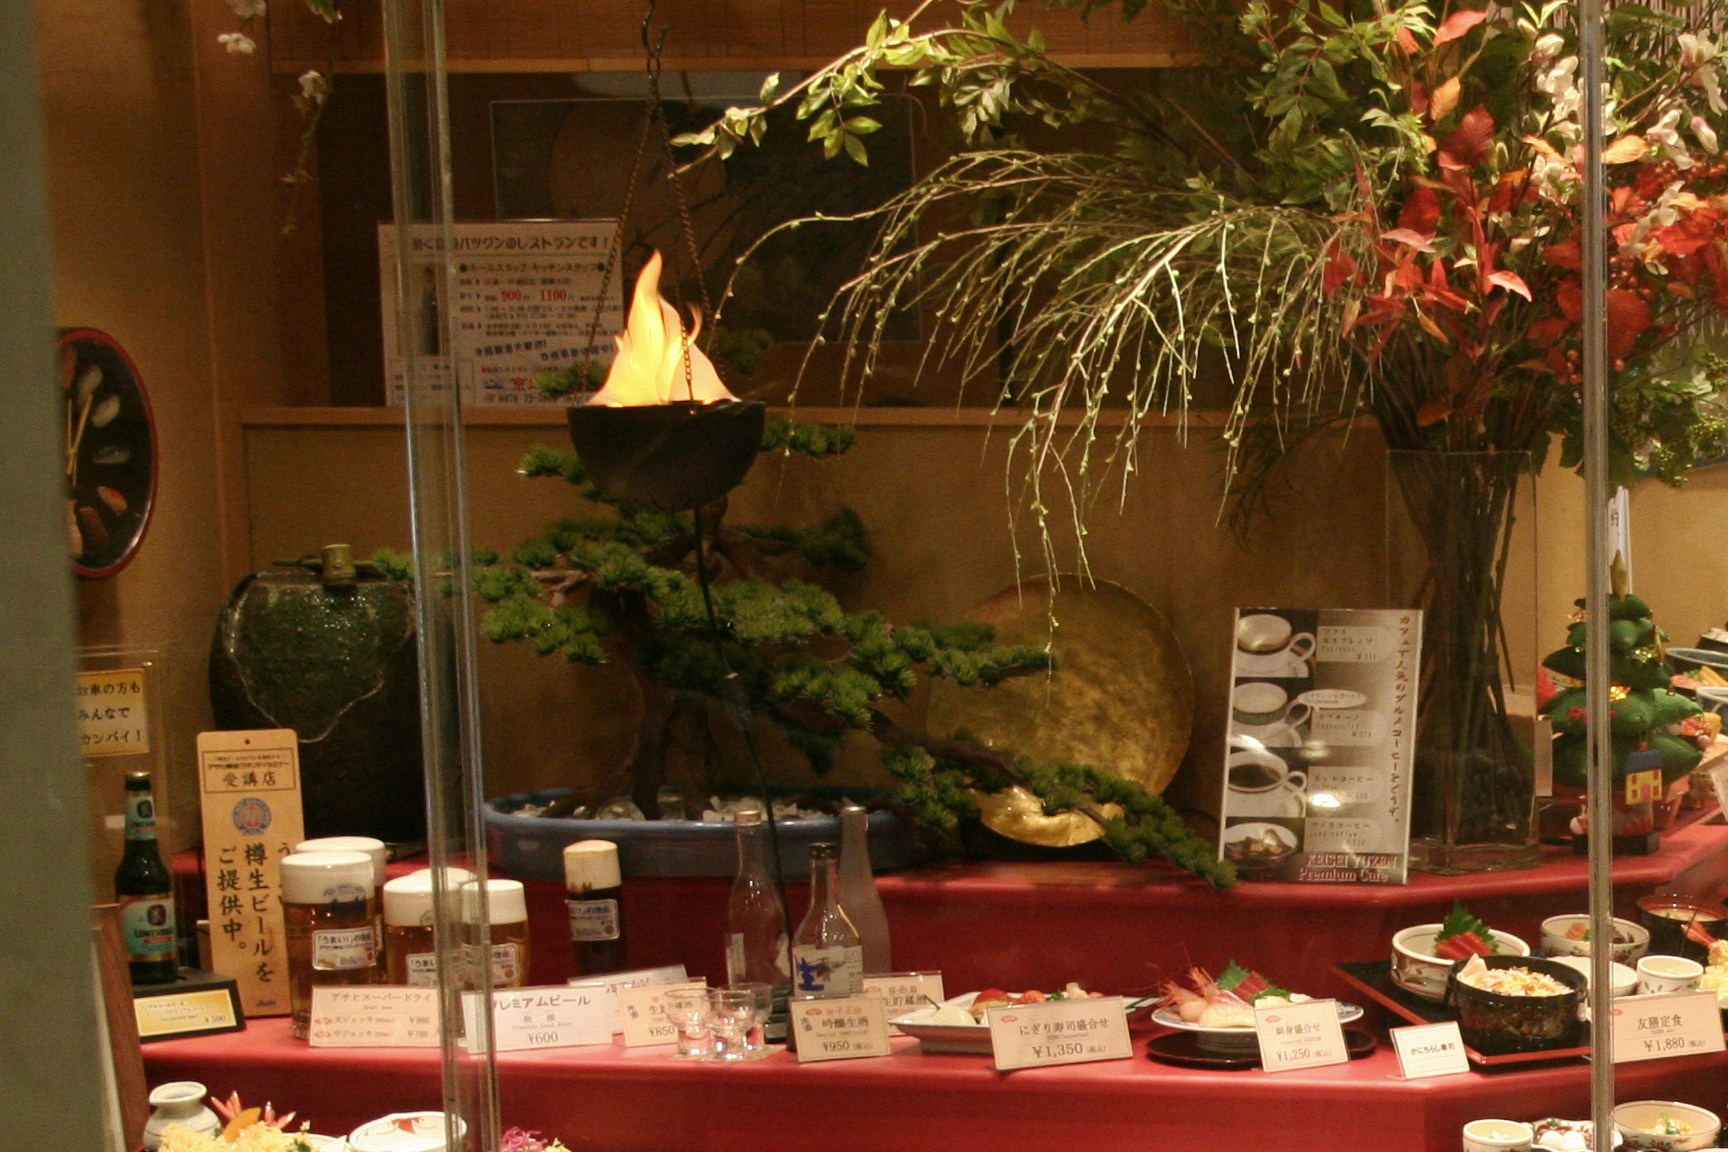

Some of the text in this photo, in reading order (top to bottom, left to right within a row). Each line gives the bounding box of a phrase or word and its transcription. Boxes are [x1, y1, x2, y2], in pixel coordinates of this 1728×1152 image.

[222, 773, 277, 788] 受講店
[217, 846, 247, 949] ご提供中。
[331, 992, 433, 1003] アサヒスーパードライ
[1019, 1017, 1111, 1037] にぎり寿司盛合せ
[1636, 1013, 1683, 1030] 友膳定食
[1275, 1023, 1321, 1036] 刺身盛合せ
[526, 1031, 560, 1046] ¥600
[1644, 1037, 1685, 1052] ¥1,880
[822, 1040, 851, 1053] ¥950
[1031, 1041, 1084, 1059] ¥1,350
[1276, 1049, 1311, 1063] ¥1,250
